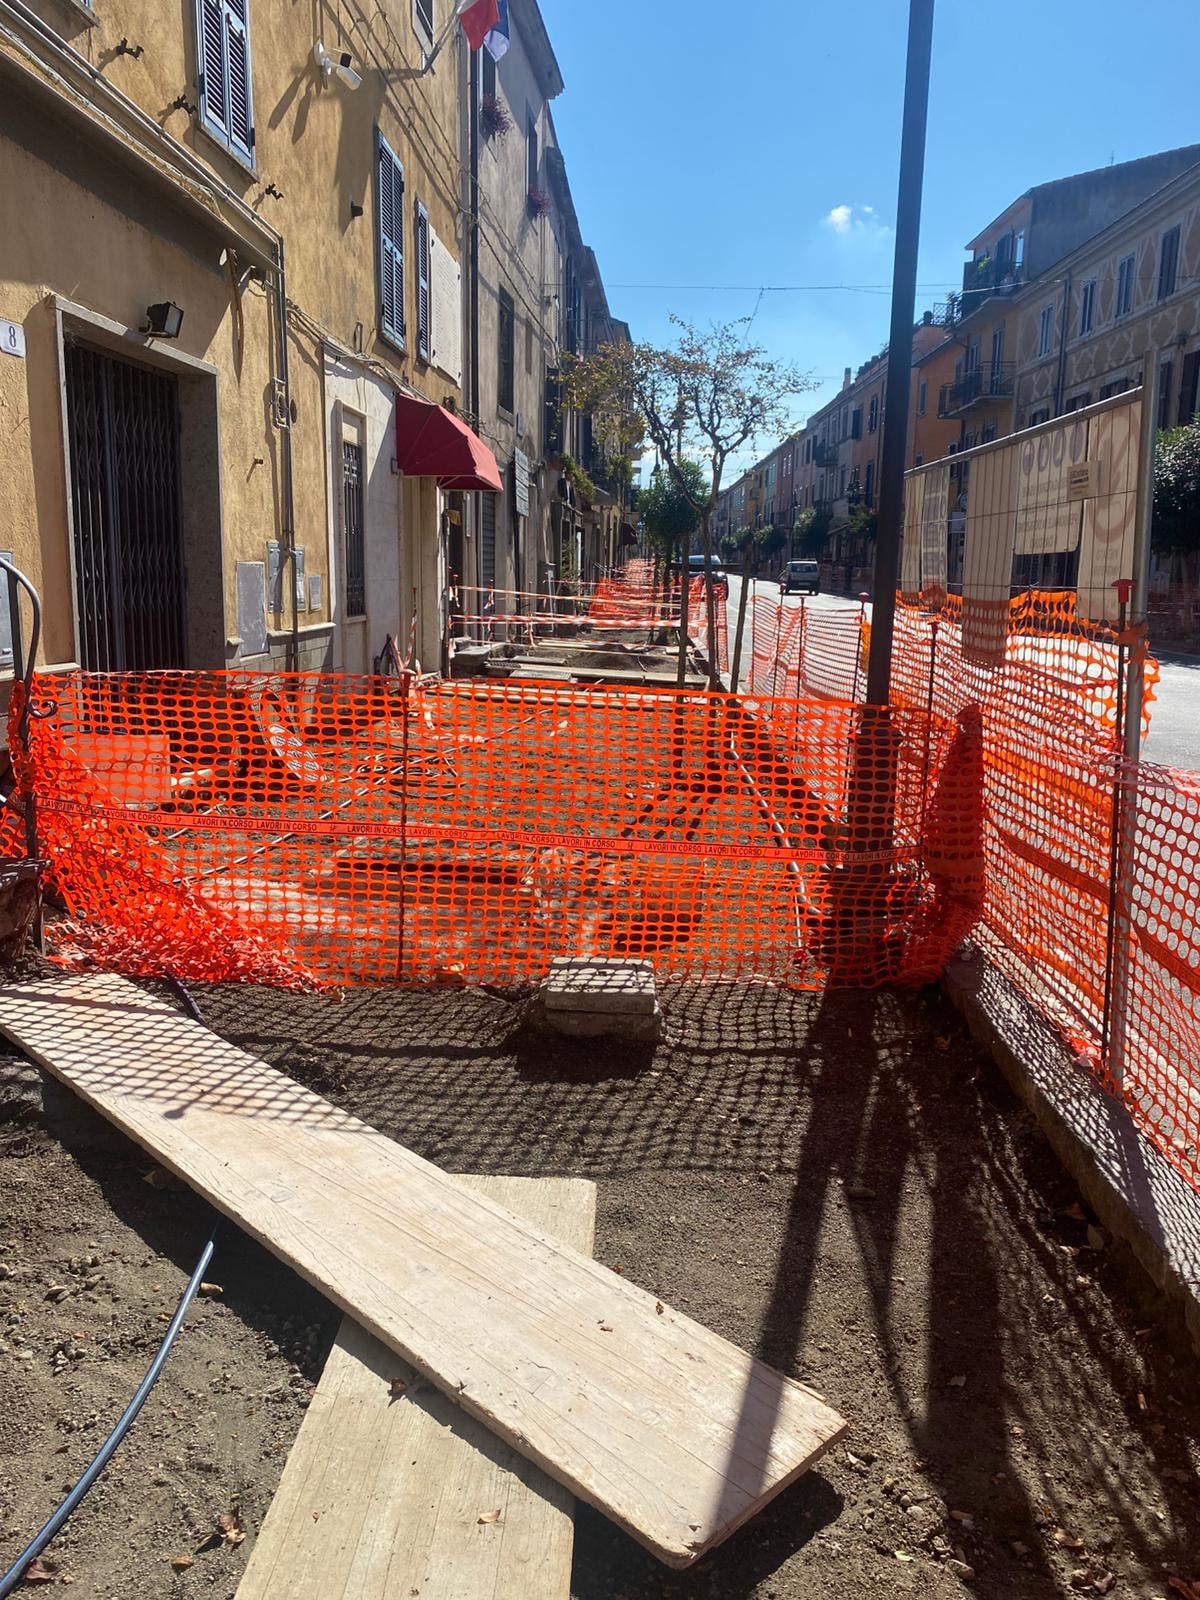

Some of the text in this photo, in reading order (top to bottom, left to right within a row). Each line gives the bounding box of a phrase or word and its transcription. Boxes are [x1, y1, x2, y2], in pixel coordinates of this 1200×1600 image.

[9, 325, 17, 348] 8
[103, 808, 129, 819] LAVORI
[138, 813, 162, 823] CORSO
[193, 818, 219, 827] LAVORI
[220, 820, 228, 828] IN
[229, 819, 253, 828] CORSO
[256, 822, 282, 830] LAVORI
[284, 823, 291, 831] IN
[293, 824, 317, 832] CORSO
[347, 825, 372, 833] LAVORI
[374, 826, 381, 834] IN
[383, 827, 406, 835] CORSO
[410, 828, 434, 836] LAVORI
[445, 830, 468, 838] CORSO
[497, 832, 523, 841] LAVORI
[523, 833, 530, 842] IN
[532, 835, 555, 844] CORSO
[558, 838, 582, 846] LAVORI
[584, 839, 590, 847] IN
[592, 840, 616, 848] CORSO
[644, 843, 668, 851] LAVORI
[678, 845, 701, 854] CORSO
[704, 847, 729, 855] LAVORI
[731, 848, 738, 856] IN
[739, 849, 762, 857] CORSO
[791, 850, 816, 859] LAVORI
[817, 852, 825, 860] IN
[826, 851, 850, 861] CORSO
[852, 854, 875, 862] LAVORI
